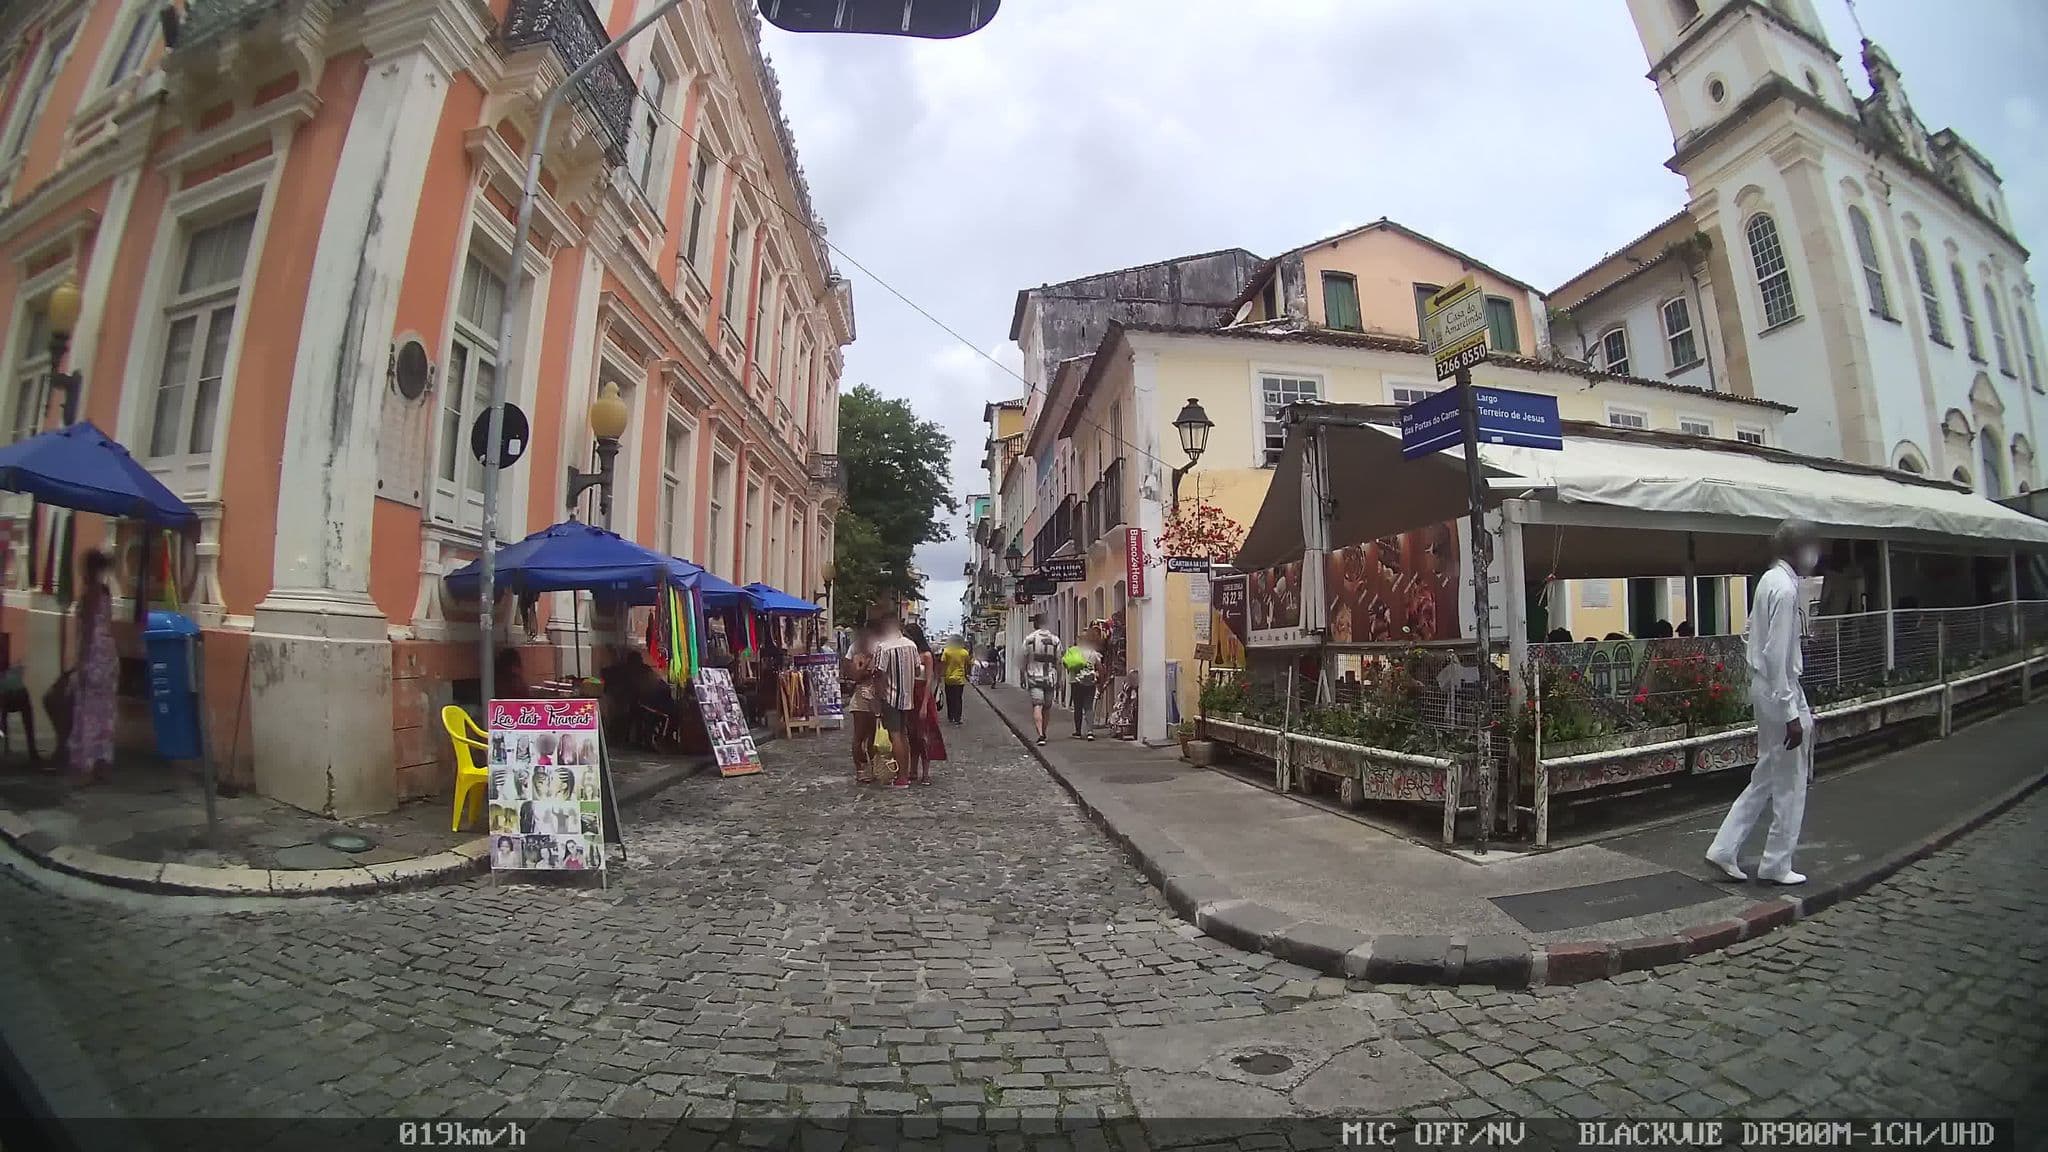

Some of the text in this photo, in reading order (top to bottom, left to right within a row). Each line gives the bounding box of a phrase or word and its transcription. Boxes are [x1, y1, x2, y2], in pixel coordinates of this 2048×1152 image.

[1446, 309, 1465, 324] Casa
[1437, 356, 1460, 377] 3266
[1462, 344, 1486, 366] 8550
[1476, 392, 1498, 404] Largo
[1415, 418, 1432, 432] Portas
[1432, 414, 1441, 425] do
[1478, 406, 1545, 424] Terreiro de Jesus
[492, 705, 517, 729] Lea
[518, 706, 541, 726] das
